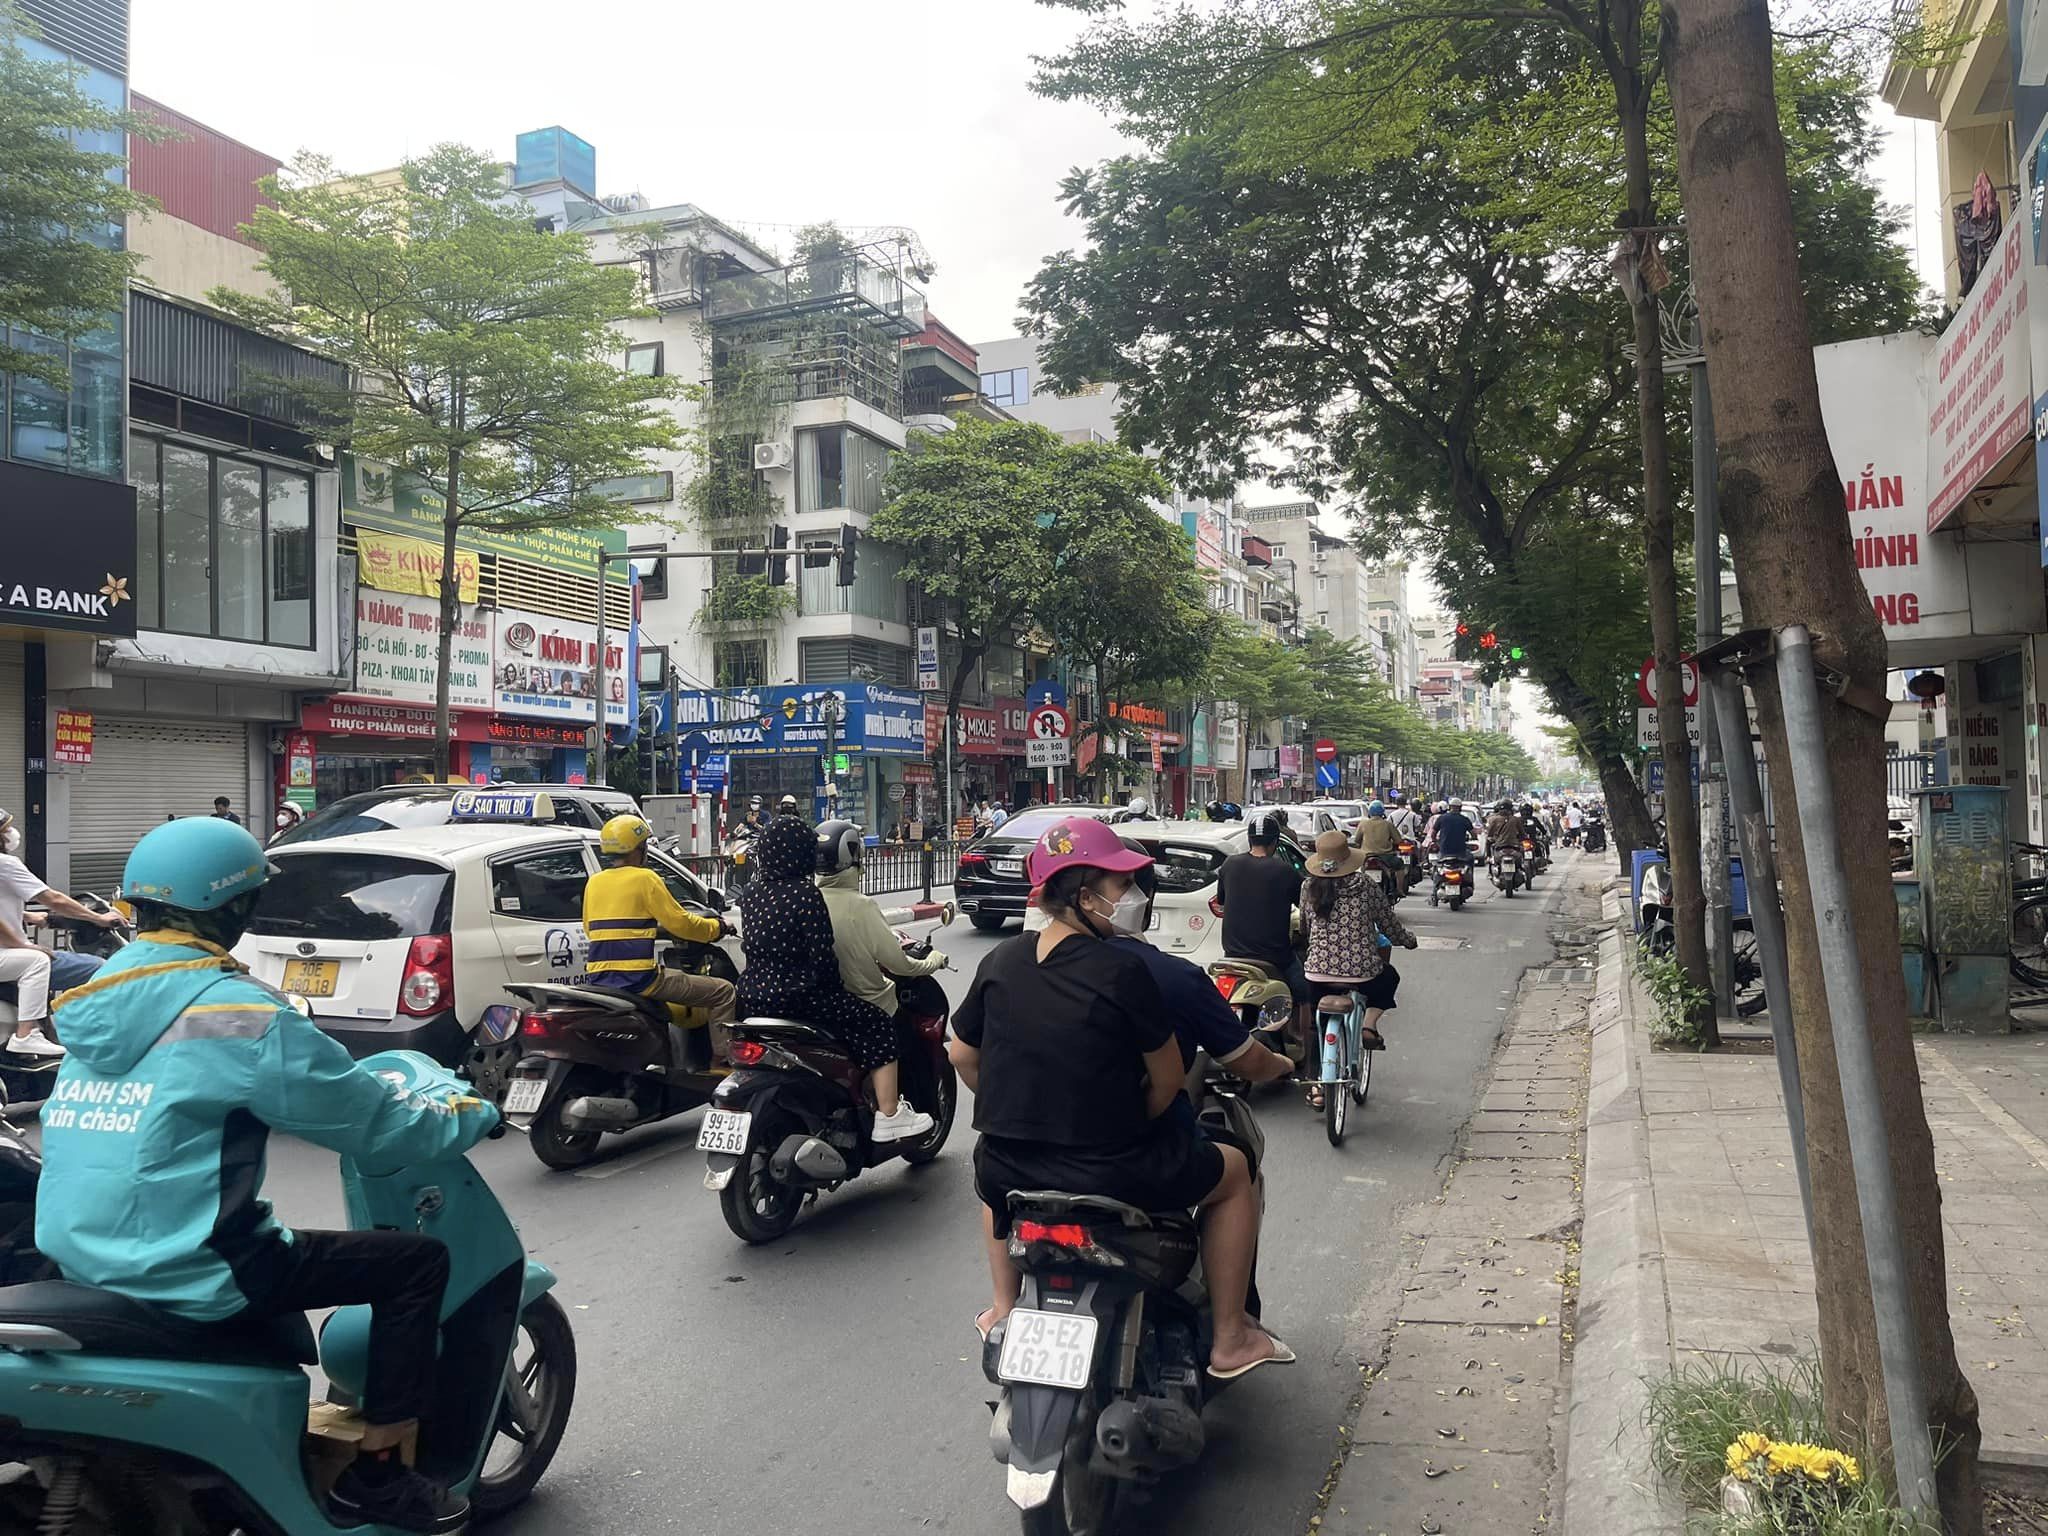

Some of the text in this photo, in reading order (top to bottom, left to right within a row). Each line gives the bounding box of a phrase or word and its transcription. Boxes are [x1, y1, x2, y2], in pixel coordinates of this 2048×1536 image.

[2004, 220, 2021, 289] 163
[9, 584, 29, 607] A
[36, 587, 108, 616] BANK
[368, 600, 404, 627] HÀNG
[408, 612, 433, 634] THỰC
[463, 621, 487, 641] SẠCH
[459, 649, 489, 666] PHOMAI
[541, 628, 582, 665] KÍNH
[361, 661, 383, 678] PIZA
[391, 665, 418, 681] KHOAI
[677, 691, 708, 723] NHÀ
[711, 688, 761, 722] THUỐC
[329, 718, 364, 732] THỰC
[367, 717, 405, 733] PHẨM
[406, 722, 430, 736] CHẾ
[967, 717, 996, 738] MIXUE
[474, 798, 493, 814] SAO
[513, 796, 526, 814] ĐÔ
[209, 869, 247, 891] XANH
[300, 962, 324, 977] 30E
[53, 1079, 154, 1107] XANH SM
[45, 1103, 141, 1133] xin chào!
[700, 1131, 743, 1151] 525.68
[1046, 1297, 1074, 1306] HONDA
[1018, 1314, 1081, 1350] 29-E2
[1005, 1346, 1086, 1383] 462.18
